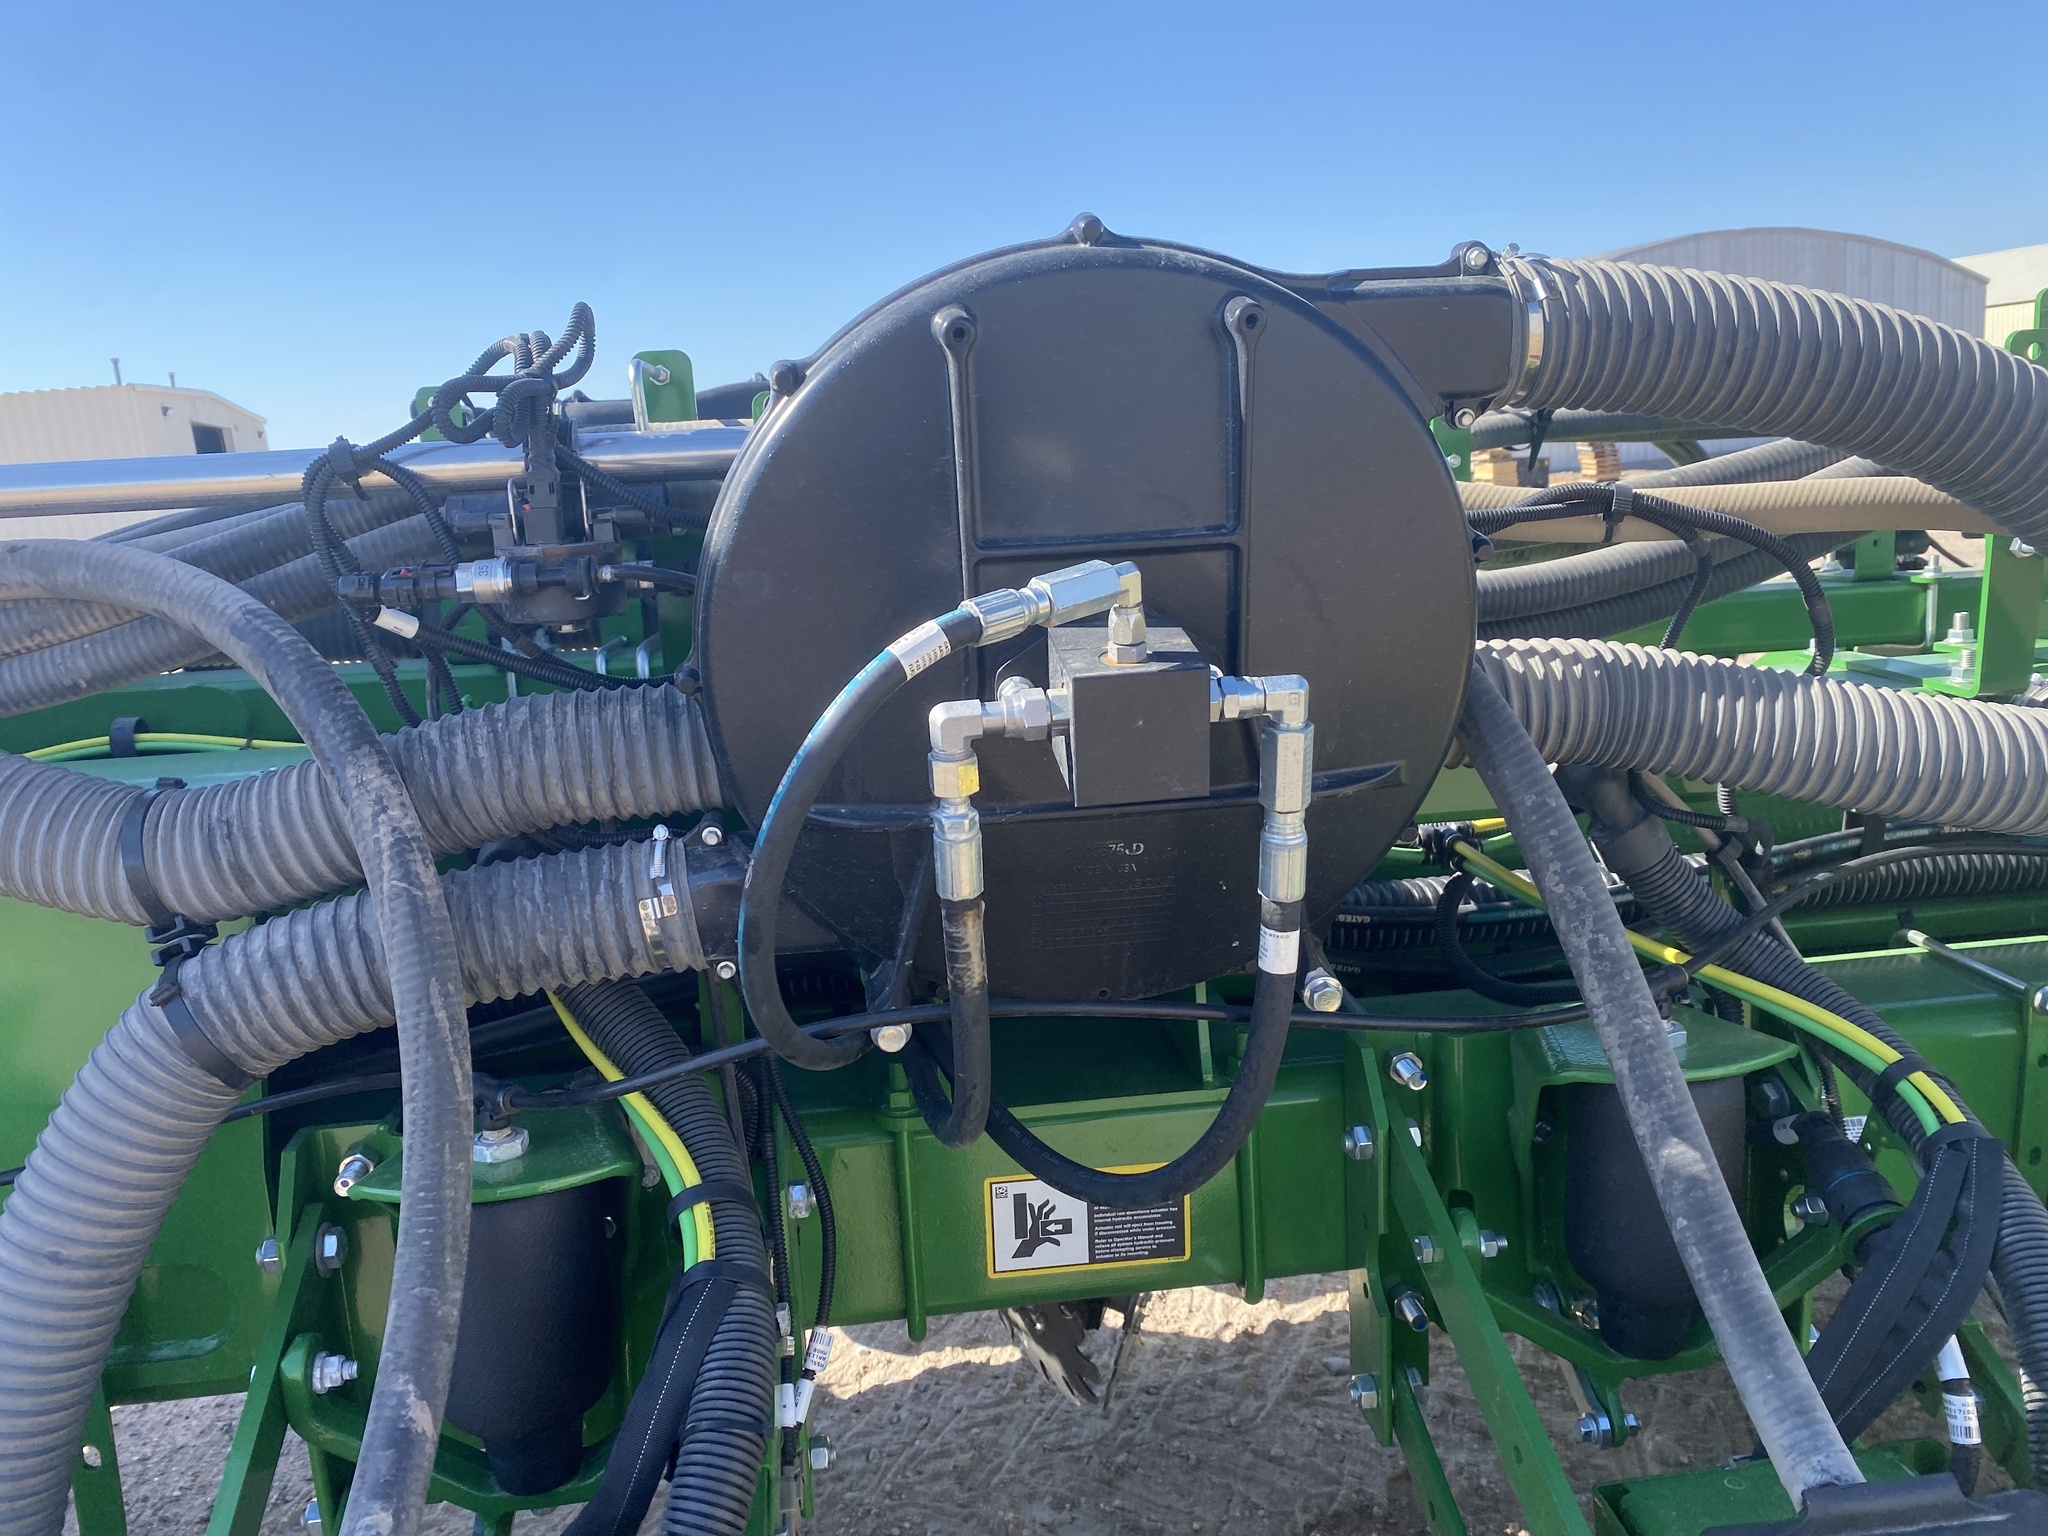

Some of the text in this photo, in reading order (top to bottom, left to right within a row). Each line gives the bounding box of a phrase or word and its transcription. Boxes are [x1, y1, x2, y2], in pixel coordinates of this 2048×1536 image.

[478, 565, 489, 577] 35
[1338, 913, 1371, 924] GATES
[1268, 932, 1290, 940] MEXICO
